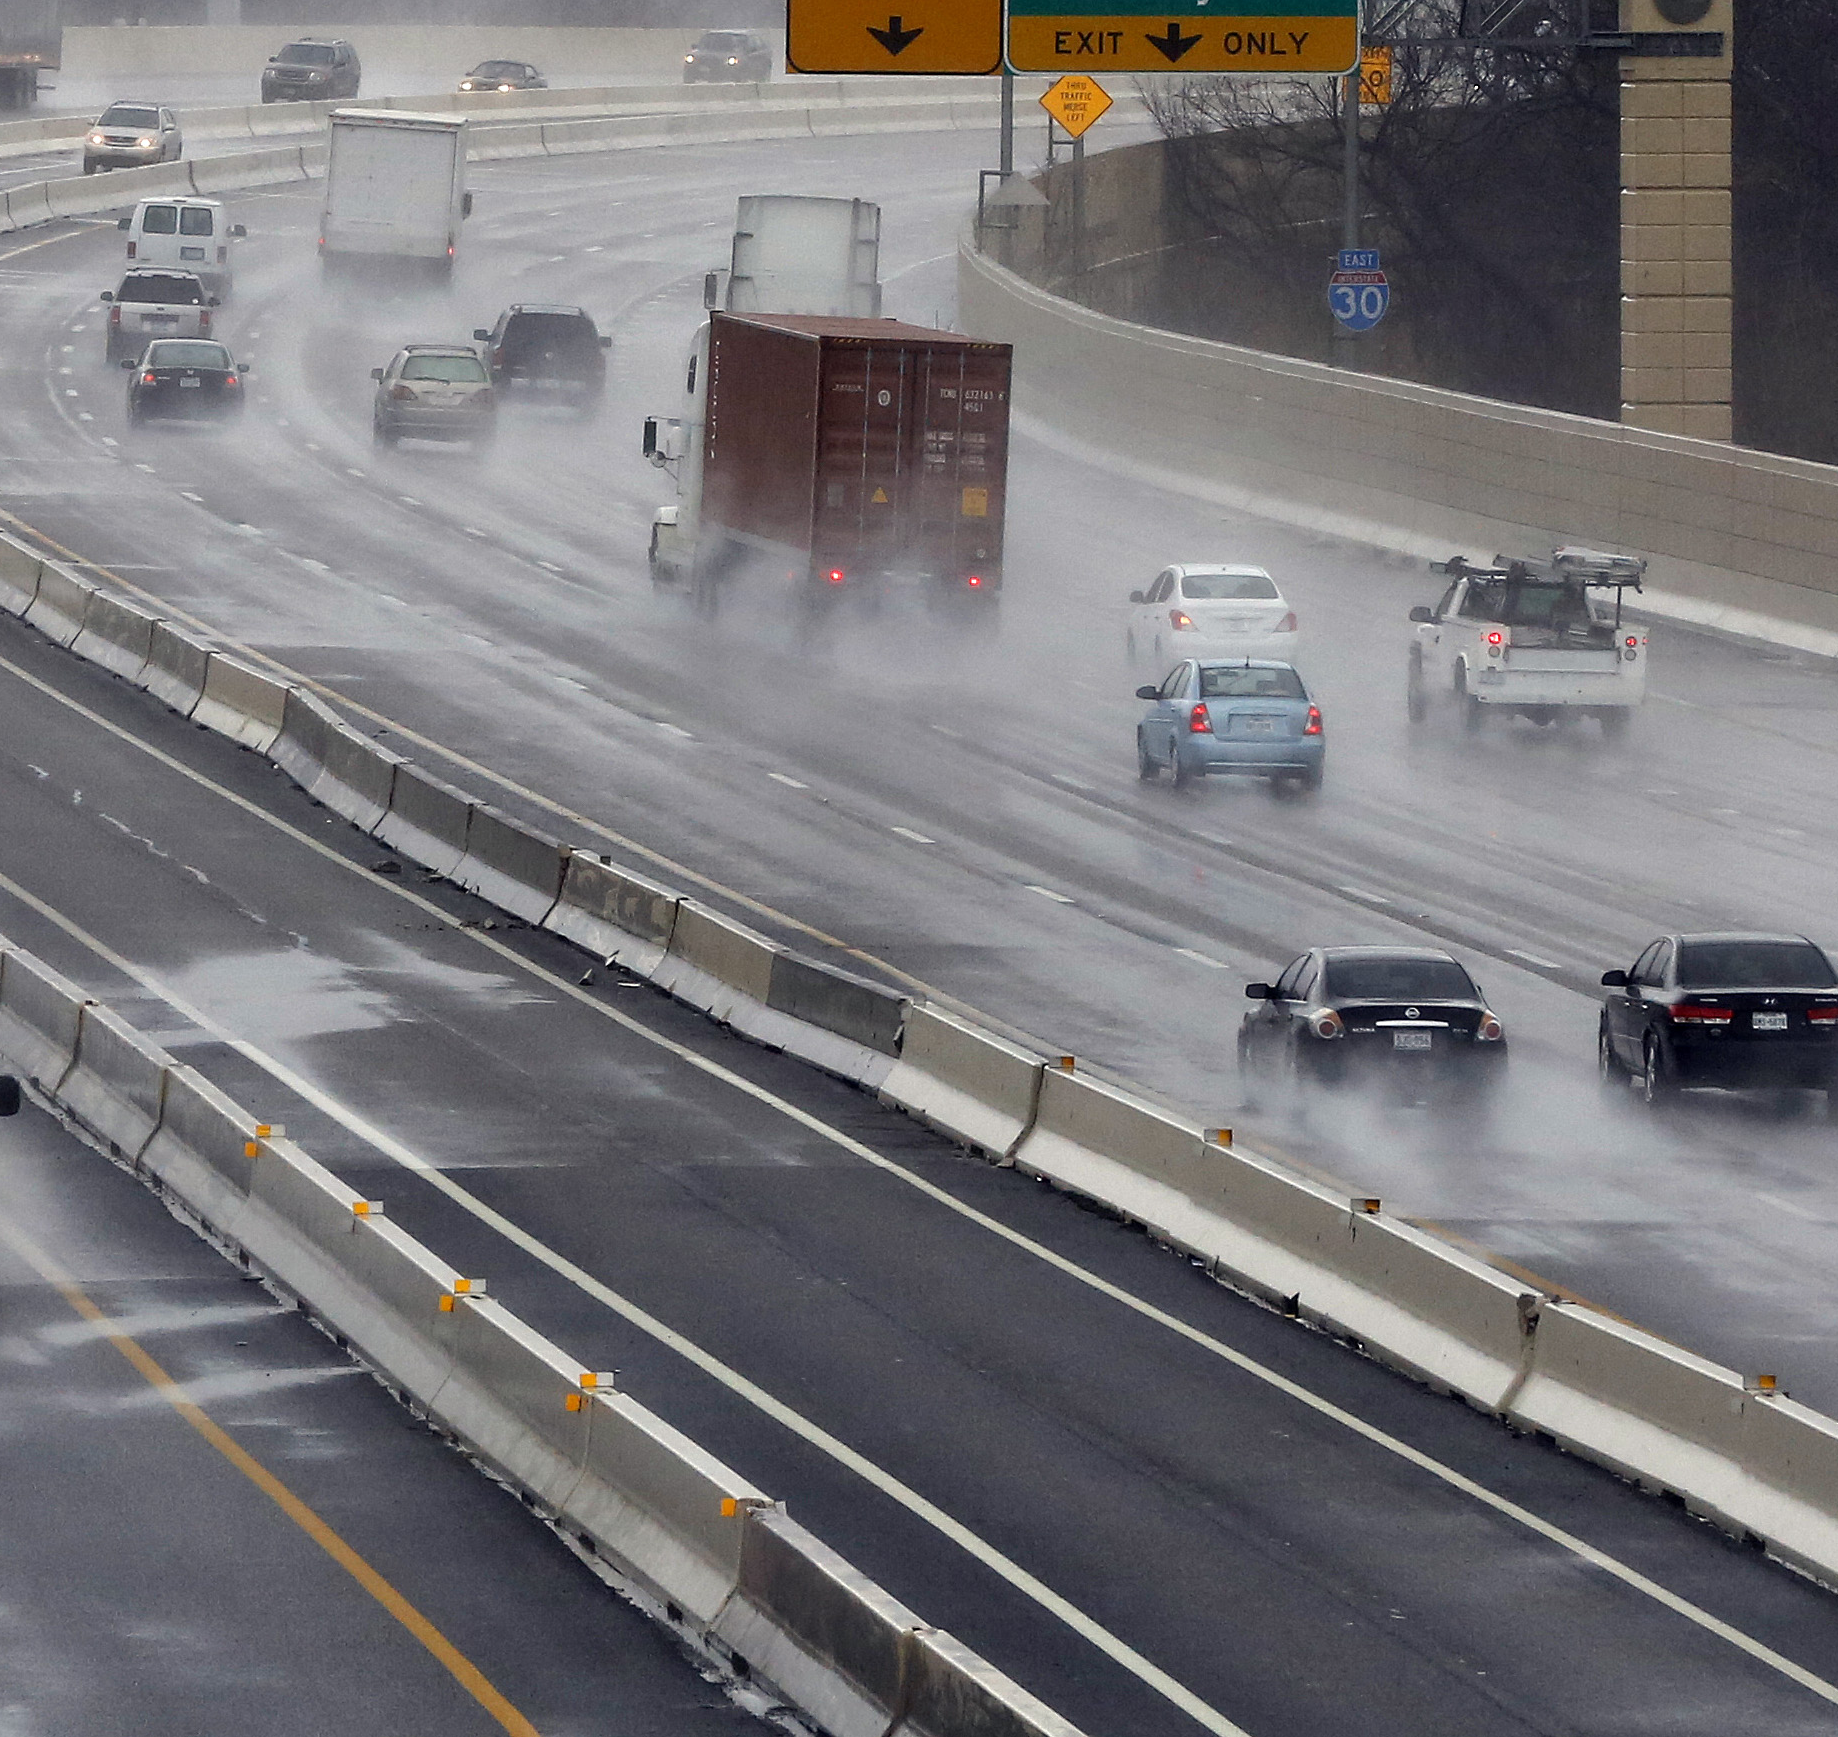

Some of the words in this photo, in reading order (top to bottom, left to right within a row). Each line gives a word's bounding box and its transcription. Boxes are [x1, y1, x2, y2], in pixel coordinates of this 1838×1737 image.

[1054, 32, 1123, 54] EXIT
[1223, 32, 1309, 54] ONLY
[1060, 92, 1092, 100] TRAFFIC
[1344, 254, 1373, 266] EAST
[1335, 286, 1382, 319] 30
